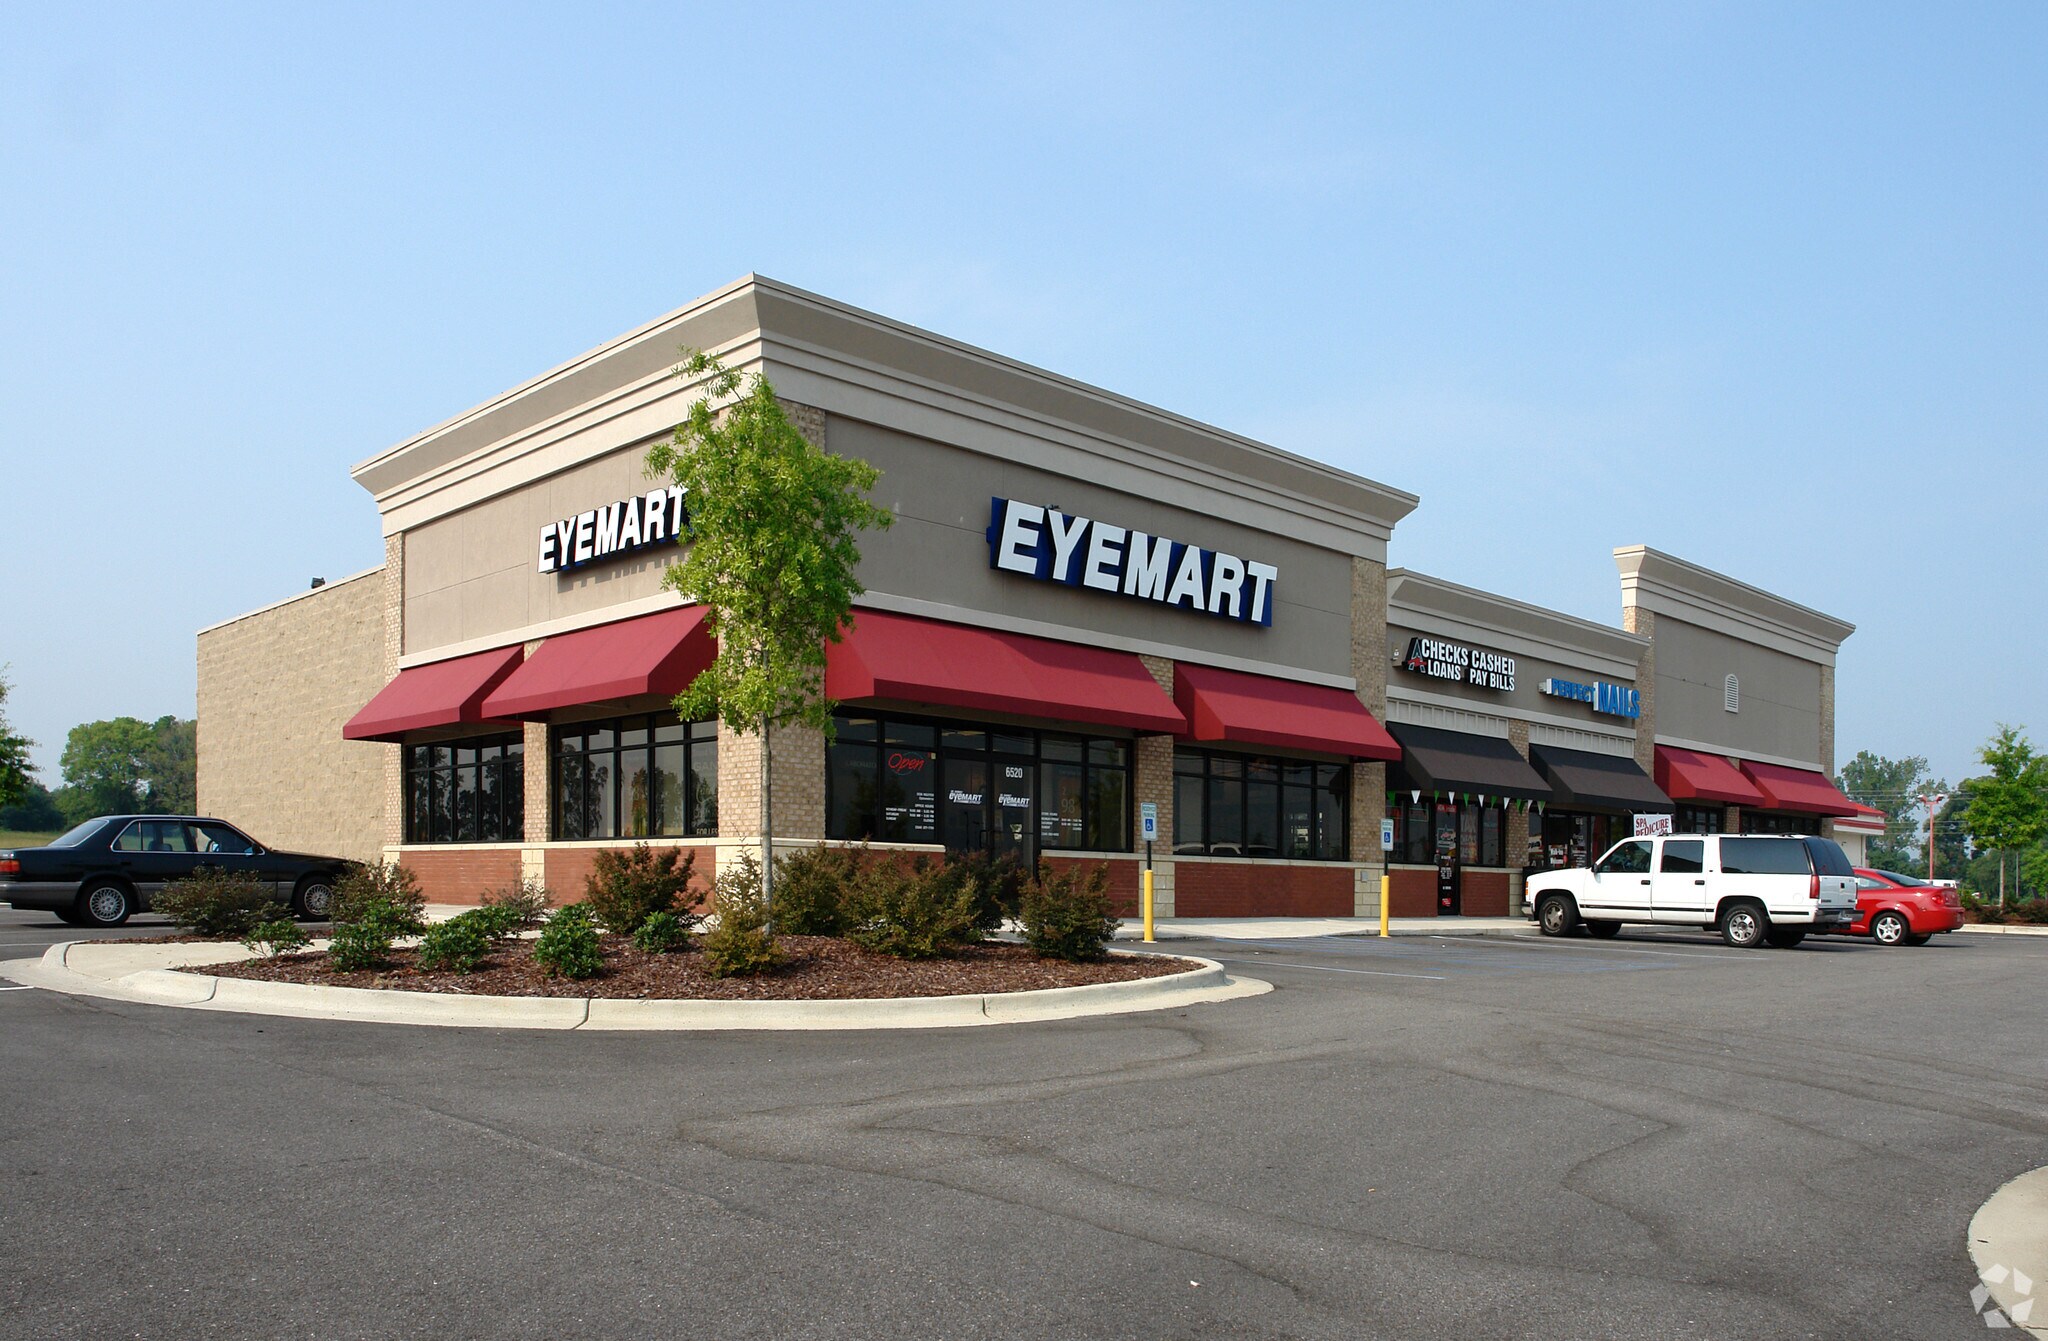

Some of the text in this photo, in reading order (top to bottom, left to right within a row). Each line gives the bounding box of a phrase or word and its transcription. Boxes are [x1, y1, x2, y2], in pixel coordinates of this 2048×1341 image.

[537, 484, 689, 574] EYEMART
[997, 499, 1279, 623] EYEMART
[1421, 638, 1469, 666] CHECKS
[1471, 650, 1515, 676] CASHED
[1427, 659, 1515, 692] LOANS PAY BILLS
[1550, 678, 1640, 719] PERFECT NAILS
[1005, 766, 1023, 779] 6520
[1636, 818, 1647, 828] SPA
